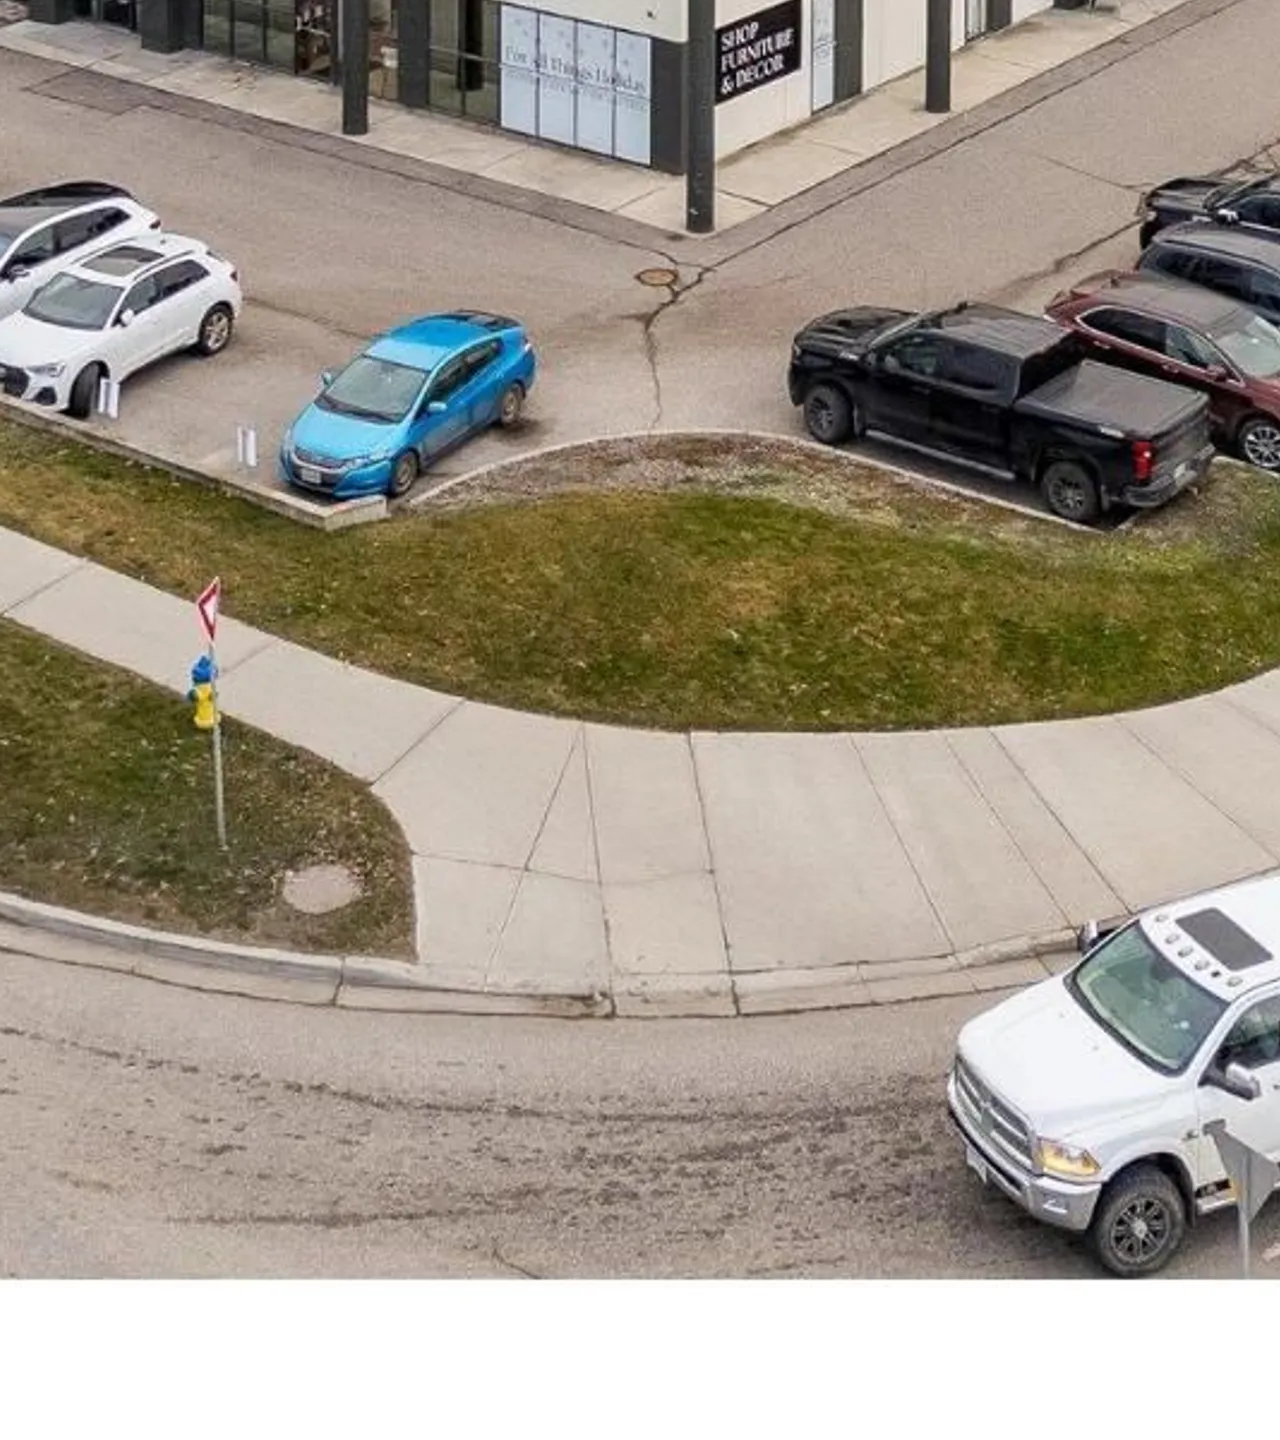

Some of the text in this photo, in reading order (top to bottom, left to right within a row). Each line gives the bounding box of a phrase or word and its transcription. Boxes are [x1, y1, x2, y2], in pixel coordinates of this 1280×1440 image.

[721, 21, 759, 51] SHOP
[721, 28, 796, 73] FURNITURE
[721, 75, 734, 95] &
[736, 54, 785, 88] DECOR
